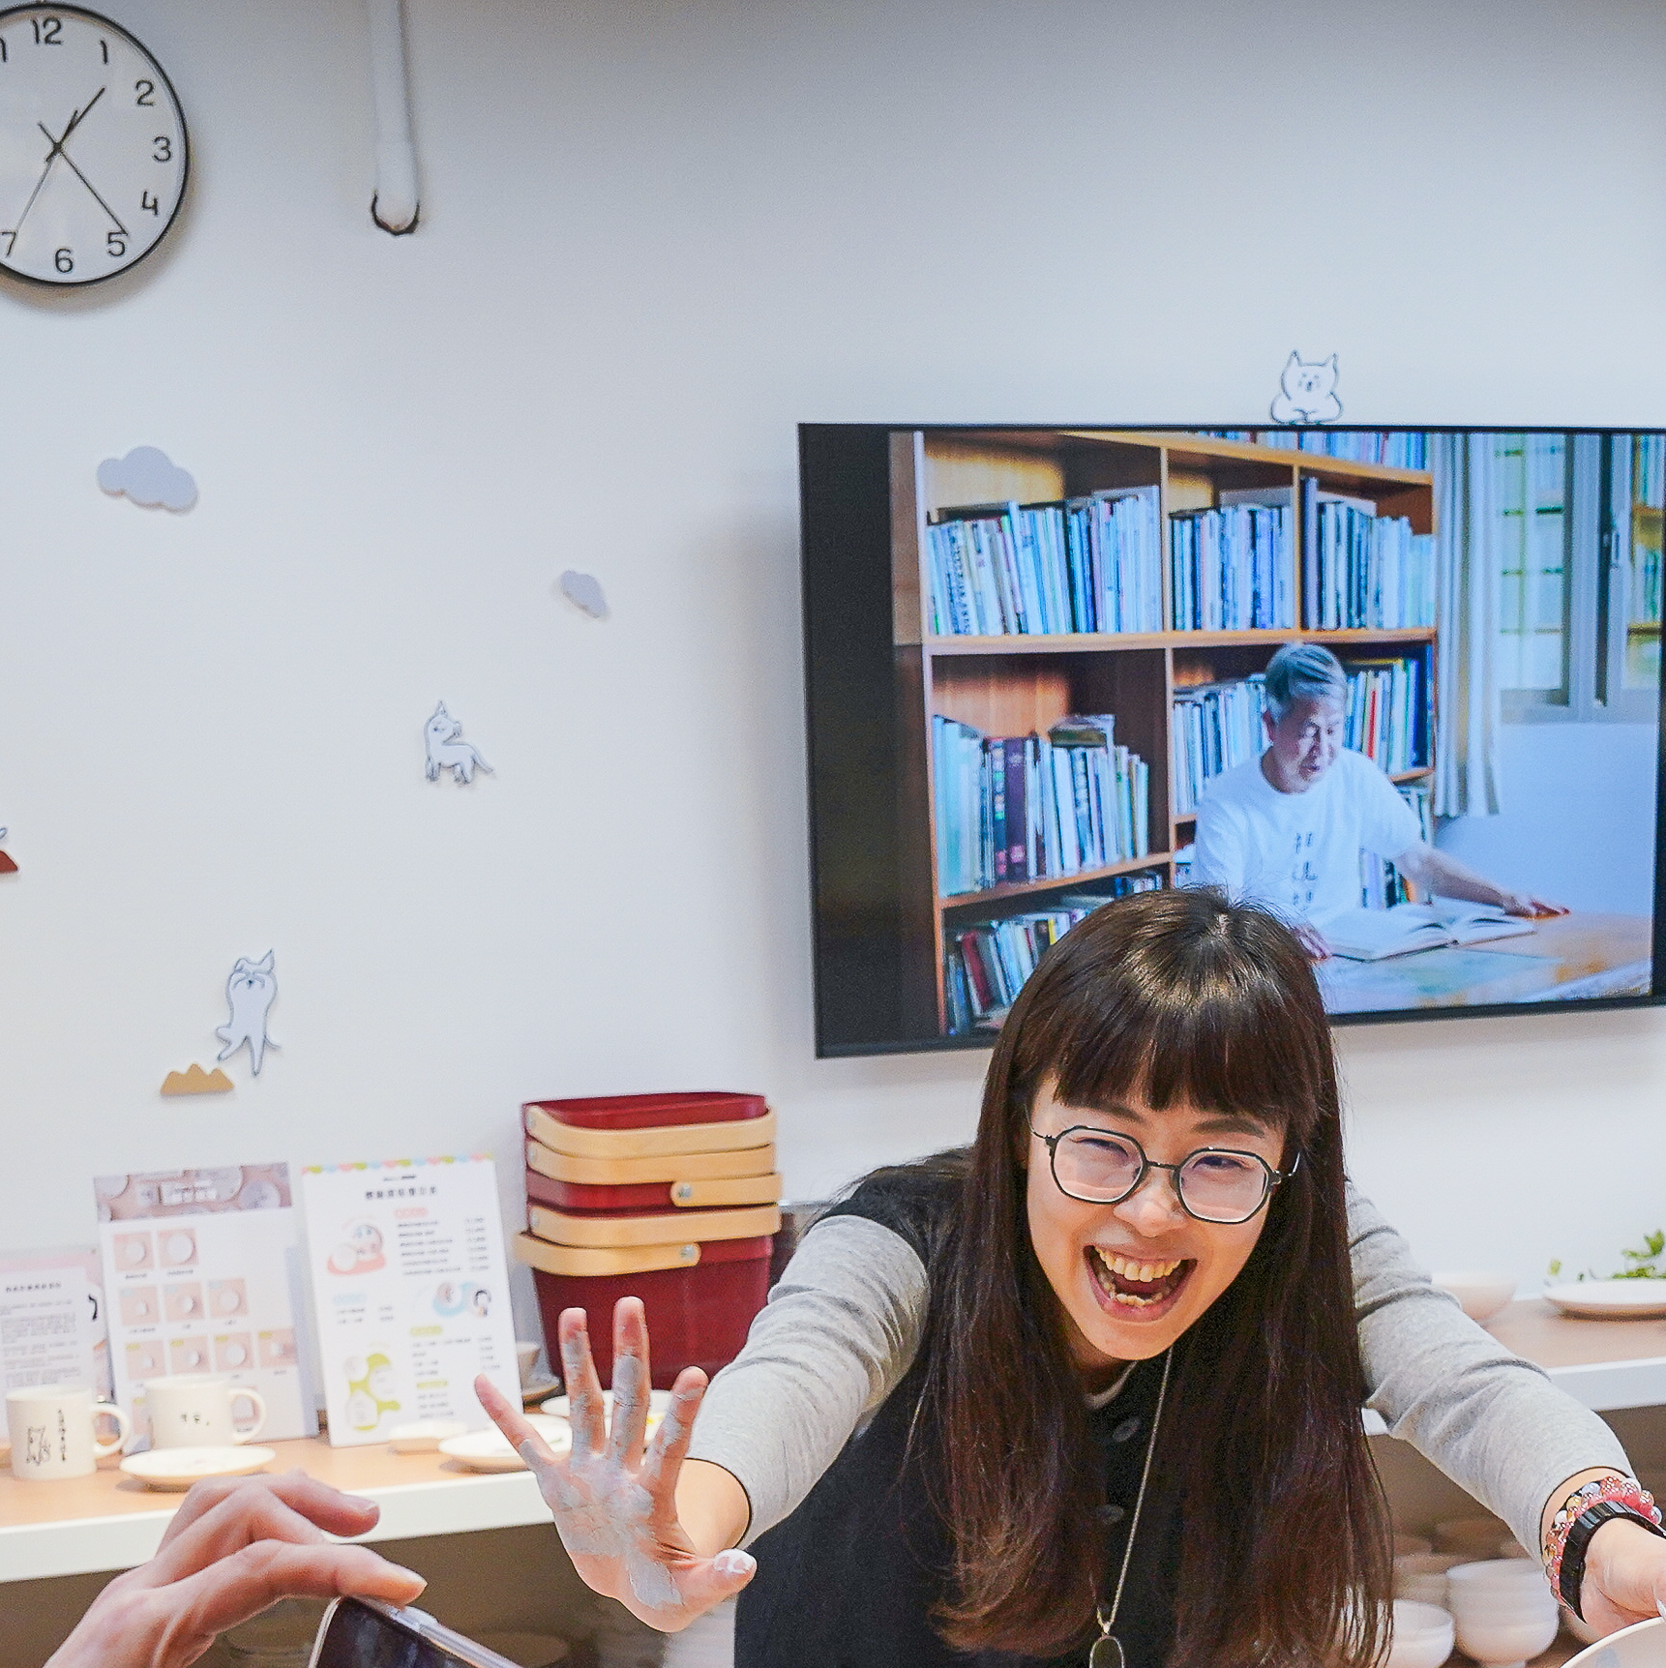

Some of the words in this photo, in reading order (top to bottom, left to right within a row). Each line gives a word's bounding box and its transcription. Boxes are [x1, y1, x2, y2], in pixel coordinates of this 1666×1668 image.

[31, 17, 62, 45] 12
[100, 39, 108, 65] 1
[136, 79, 155, 107] 2
[152, 135, 173, 163] 3
[140, 190, 159, 216] 4
[0, 230, 18, 258] 7
[106, 230, 127, 257] 5
[54, 247, 74, 274] 6
